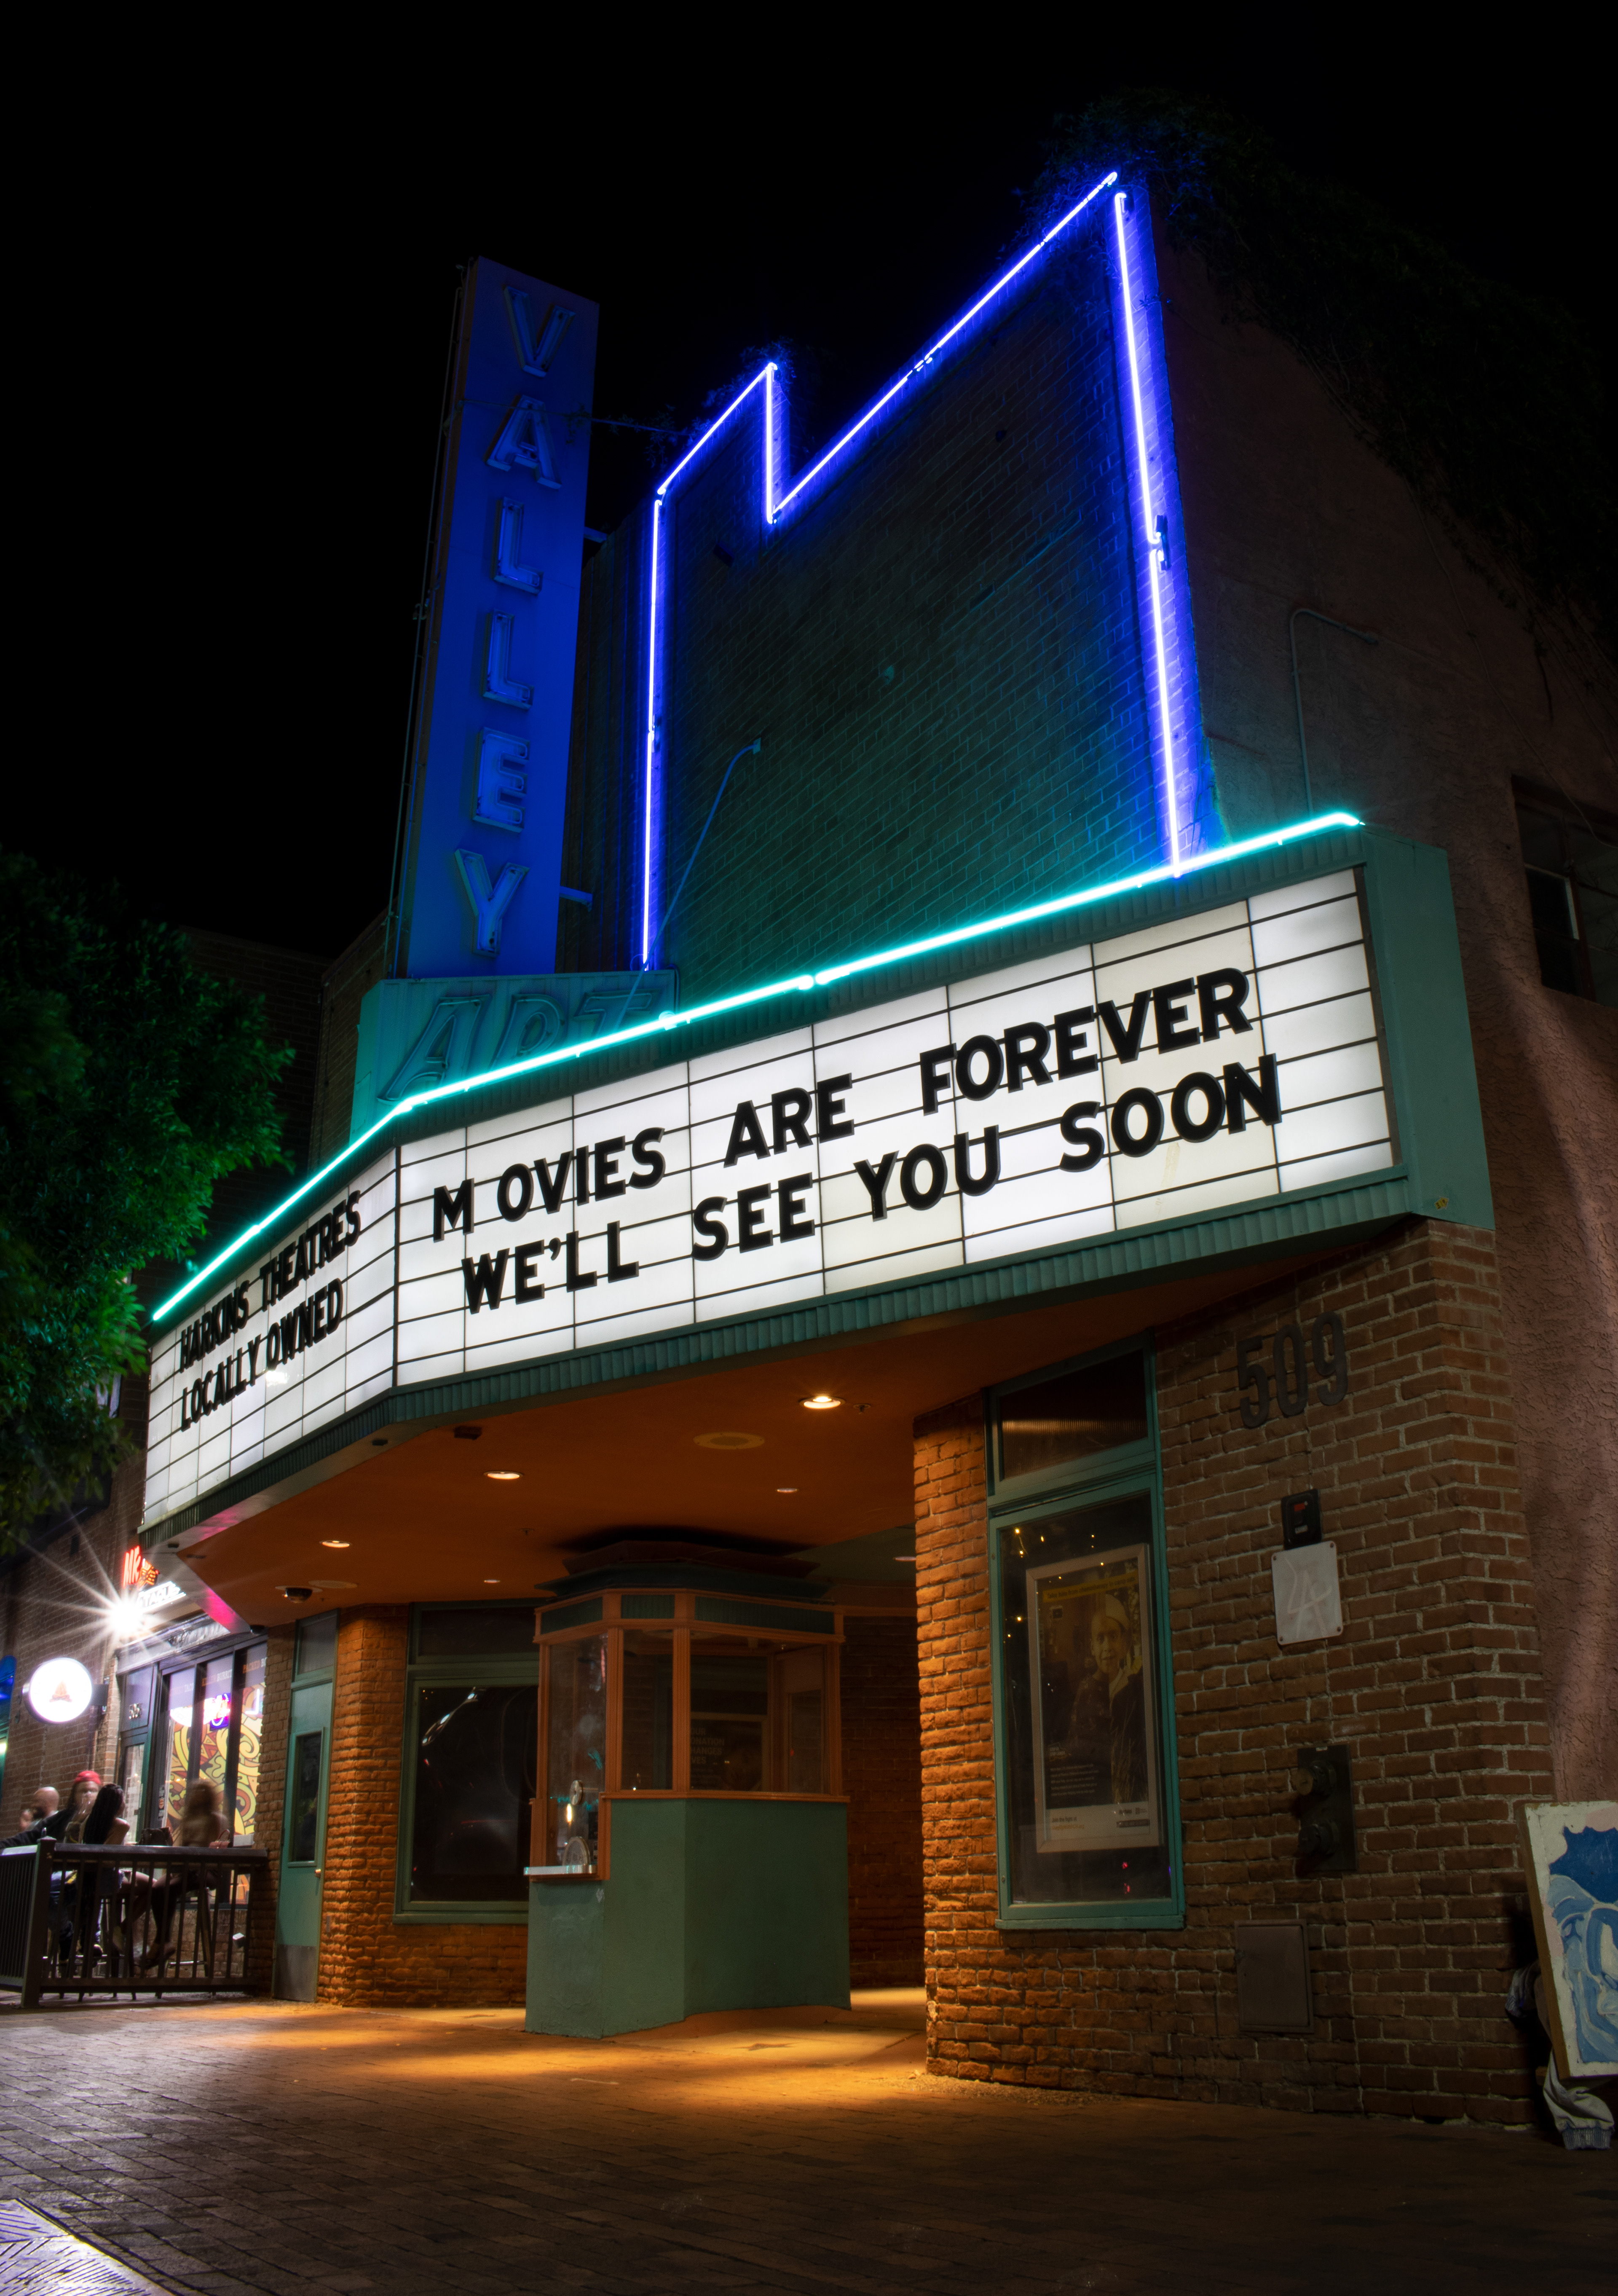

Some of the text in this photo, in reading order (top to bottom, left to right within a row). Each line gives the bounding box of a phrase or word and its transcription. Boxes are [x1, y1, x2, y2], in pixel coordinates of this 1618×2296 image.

[454, 285, 576, 958] VALLEY
[723, 1073, 855, 1168] ARE
[920, 967, 1251, 1114] FOREVER
[462, 1054, 1281, 1314] WE'LL SEE YOU SOON
[179, 1190, 361, 1374] HARKINS THEATRES
[181, 1277, 344, 1432] LOCALLY OWNED
[1237, 1311, 1347, 1428] 509
[691, 1737, 725, 1746] ONATION
[691, 1747, 722, 1755] HANGES
[691, 1757, 707, 1765] VES
